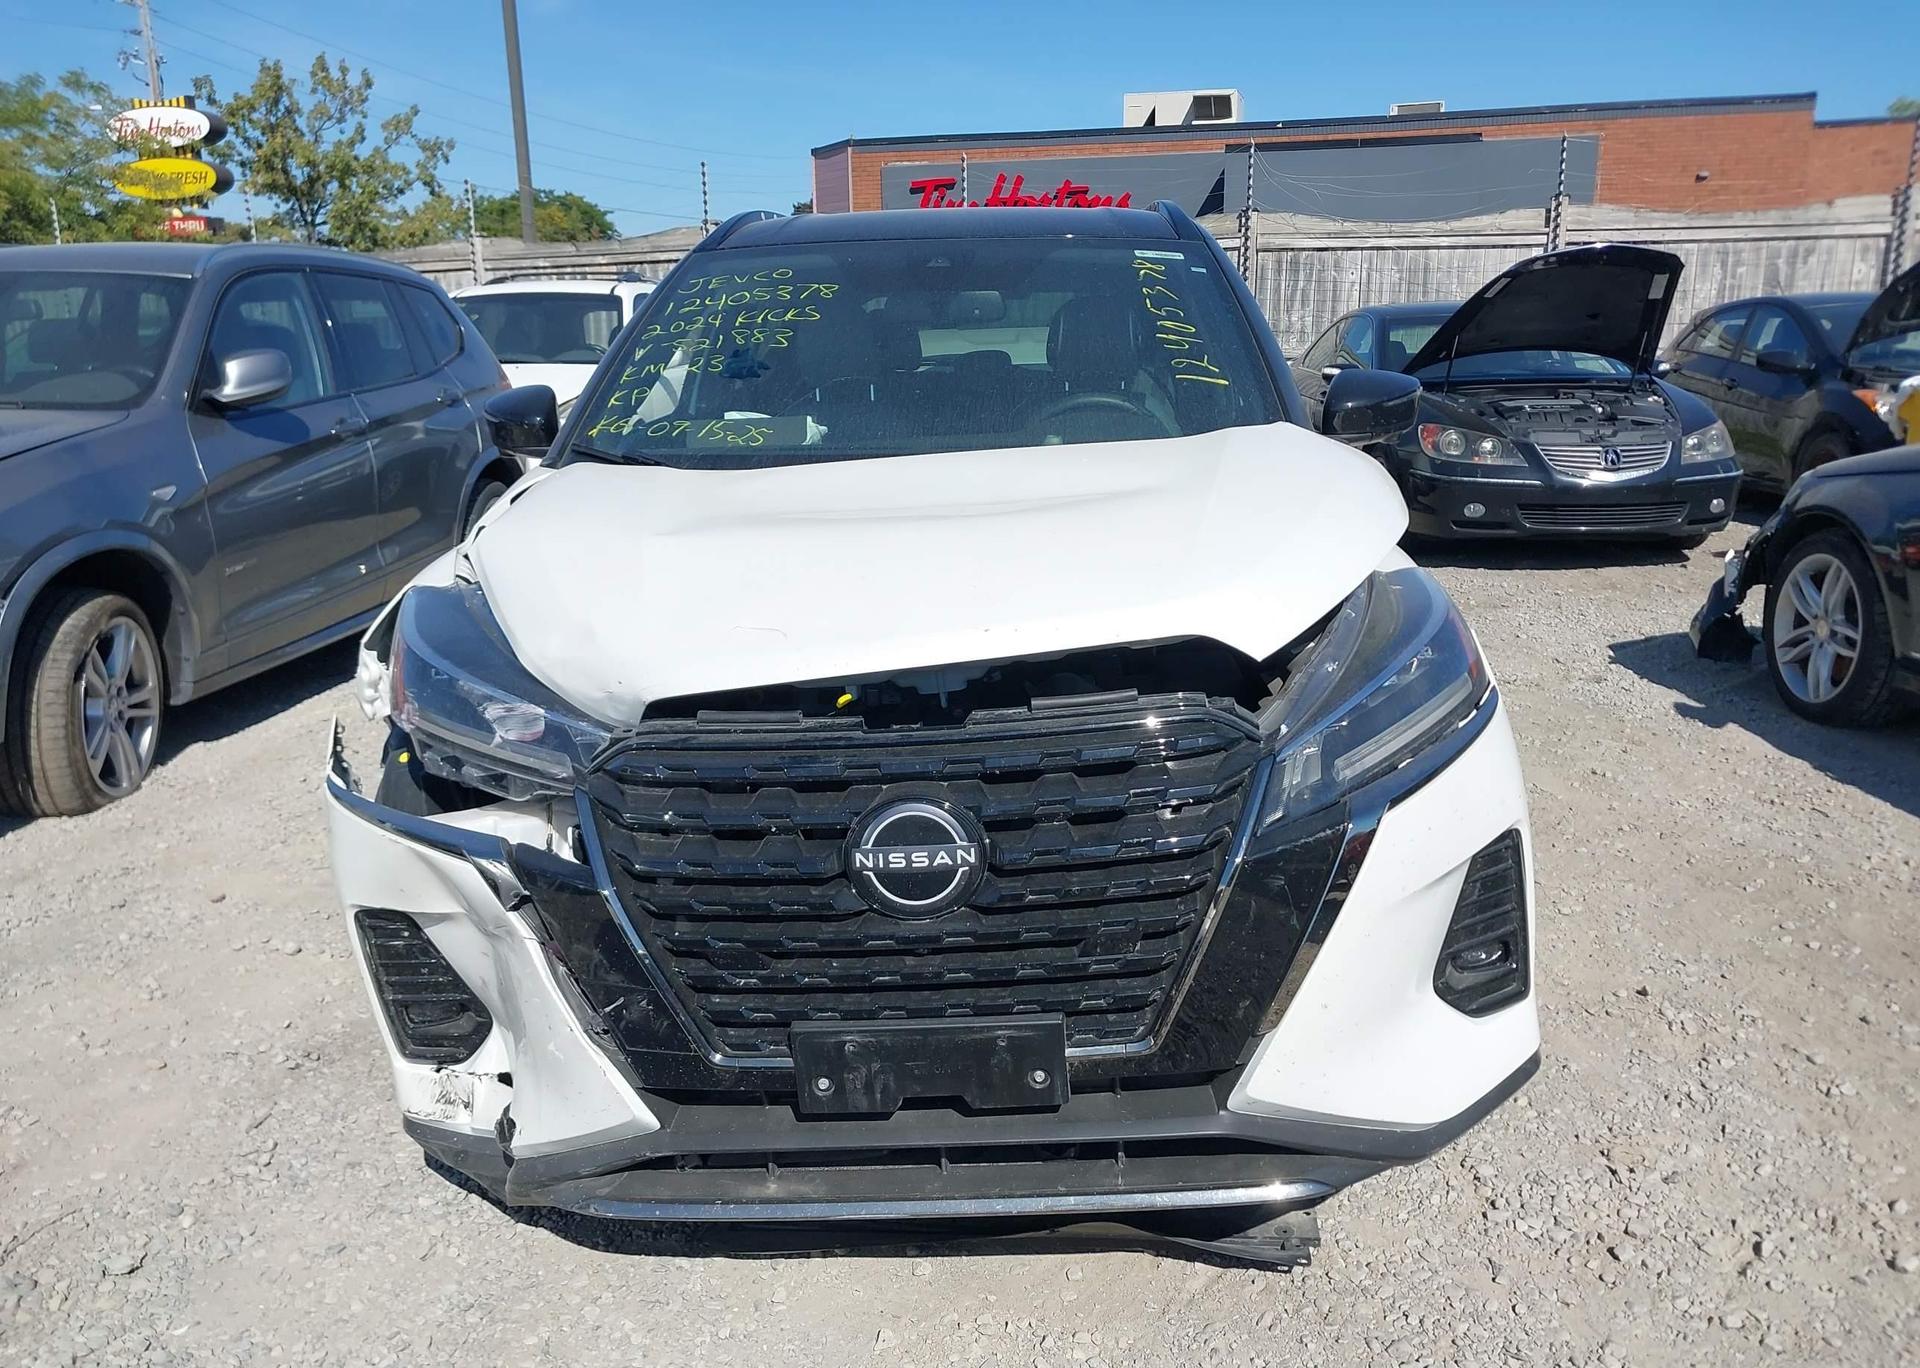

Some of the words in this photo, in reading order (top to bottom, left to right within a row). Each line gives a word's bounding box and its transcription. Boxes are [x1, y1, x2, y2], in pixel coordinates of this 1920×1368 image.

[678, 269, 793, 294] JEVCO
[665, 284, 839, 316] 12405378
[641, 313, 724, 340] 2024
[735, 305, 821, 327] KICKS
[620, 363, 665, 384] KM
[855, 847, 976, 868] NISSAN
